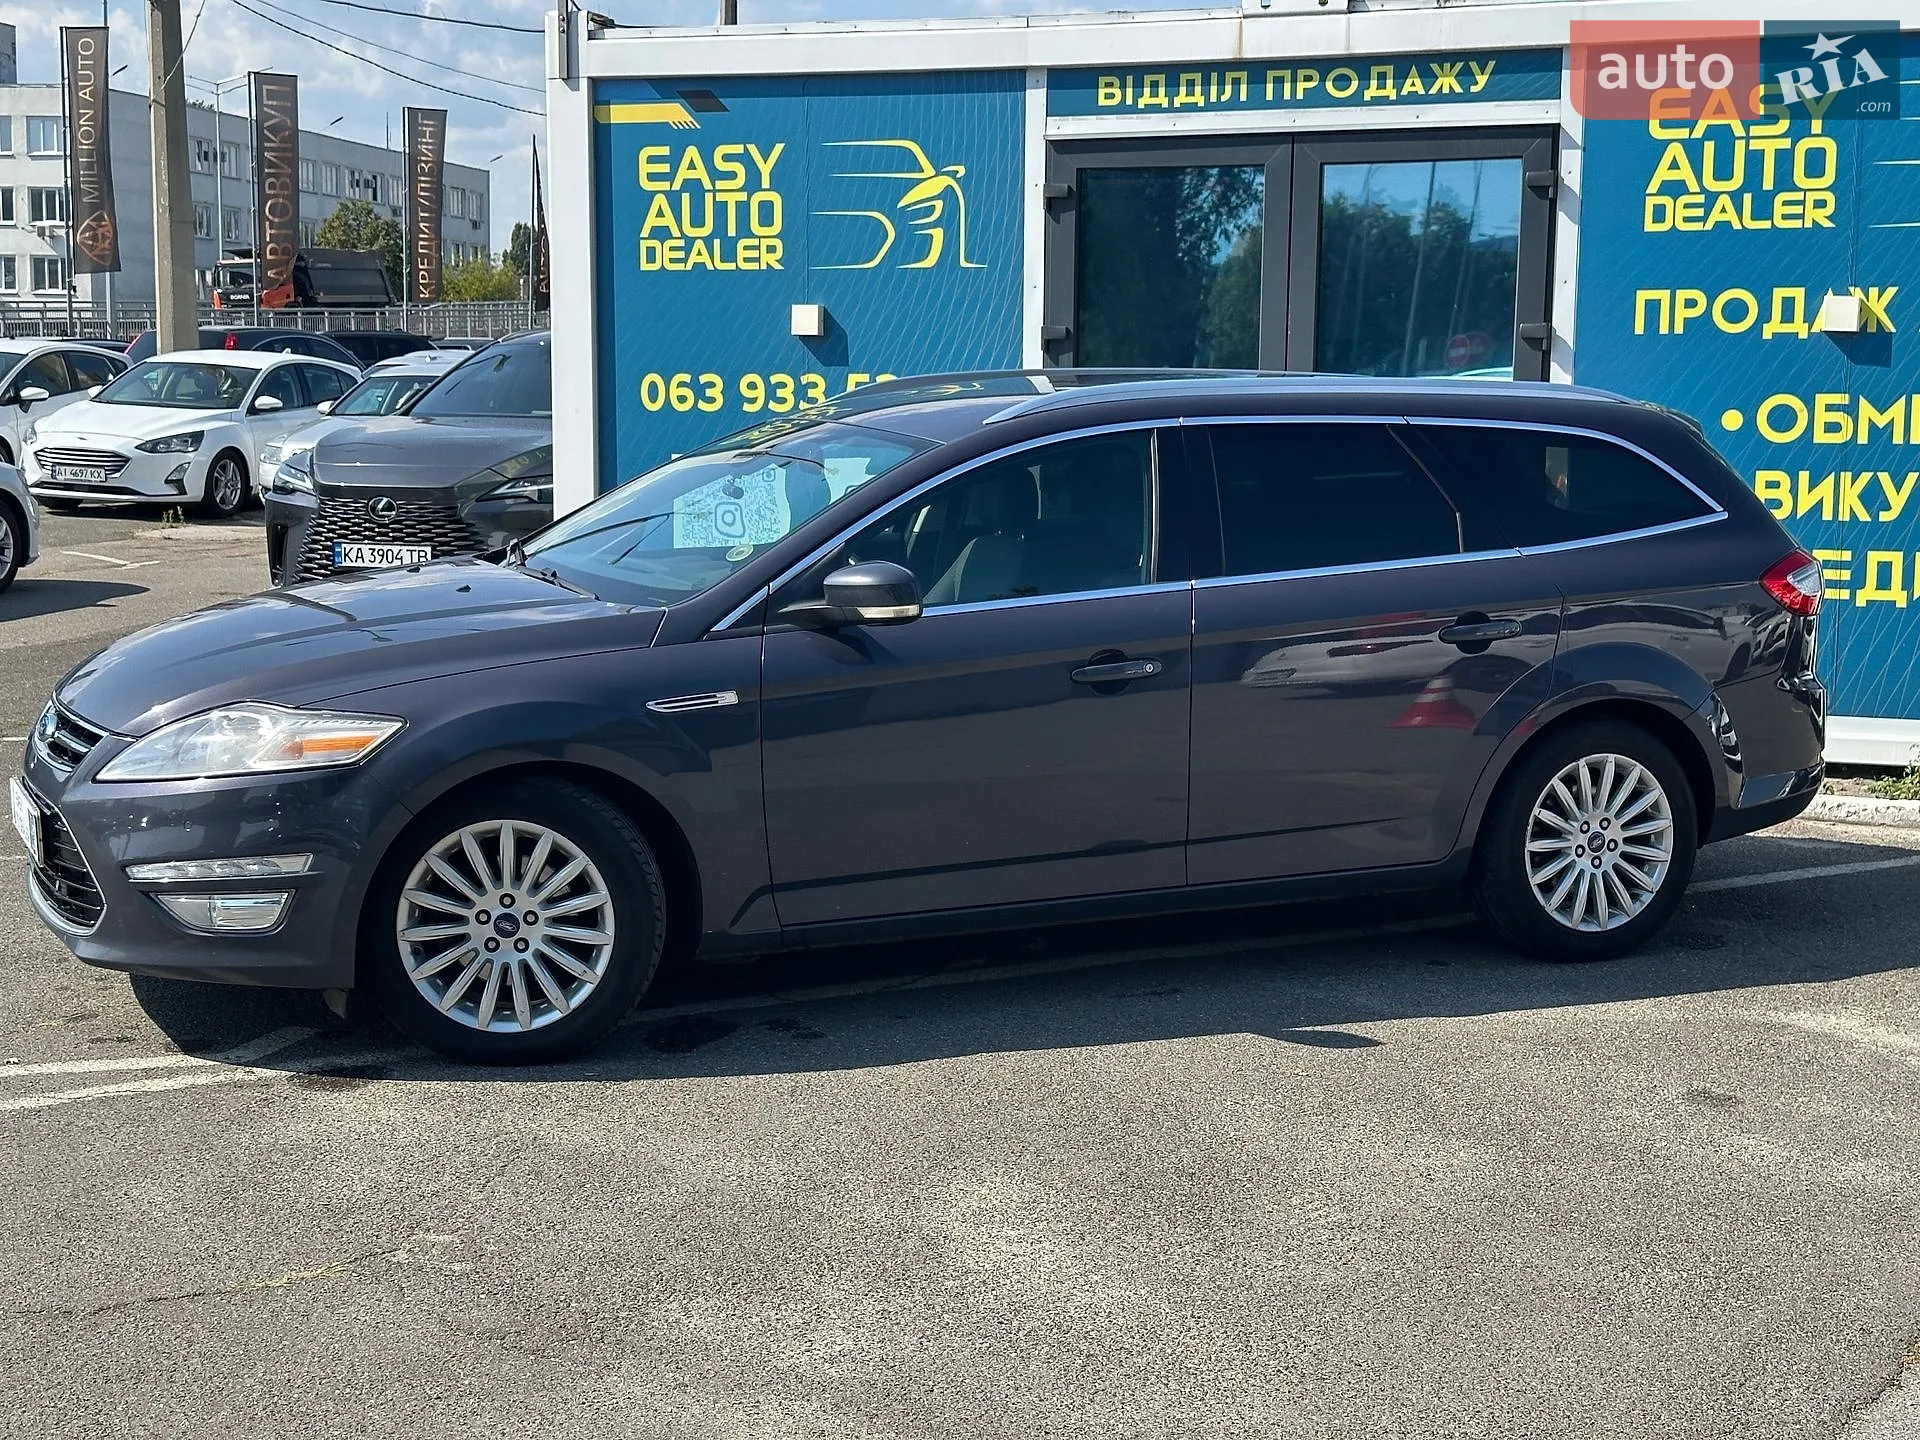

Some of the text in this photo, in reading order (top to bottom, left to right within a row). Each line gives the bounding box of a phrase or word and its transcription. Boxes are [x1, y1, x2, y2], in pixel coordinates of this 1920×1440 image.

[1098, 60, 1496, 108] ВІДДІЛ ПРОДАЖУ
[78, 37, 100, 203] MILLION AUTO
[1648, 82, 1842, 140] EASY
[262, 84, 294, 285] АВТОВИКУП
[638, 142, 786, 191] EASY
[1645, 136, 1838, 194] AUTO
[639, 190, 783, 238] AUTO
[1643, 190, 1836, 233] DEALER
[639, 237, 785, 271] DEALER
[640, 373, 724, 412] 063
[739, 373, 827, 412] 933
[343, 546, 365, 564] KA
[368, 548, 403, 565] 3904
